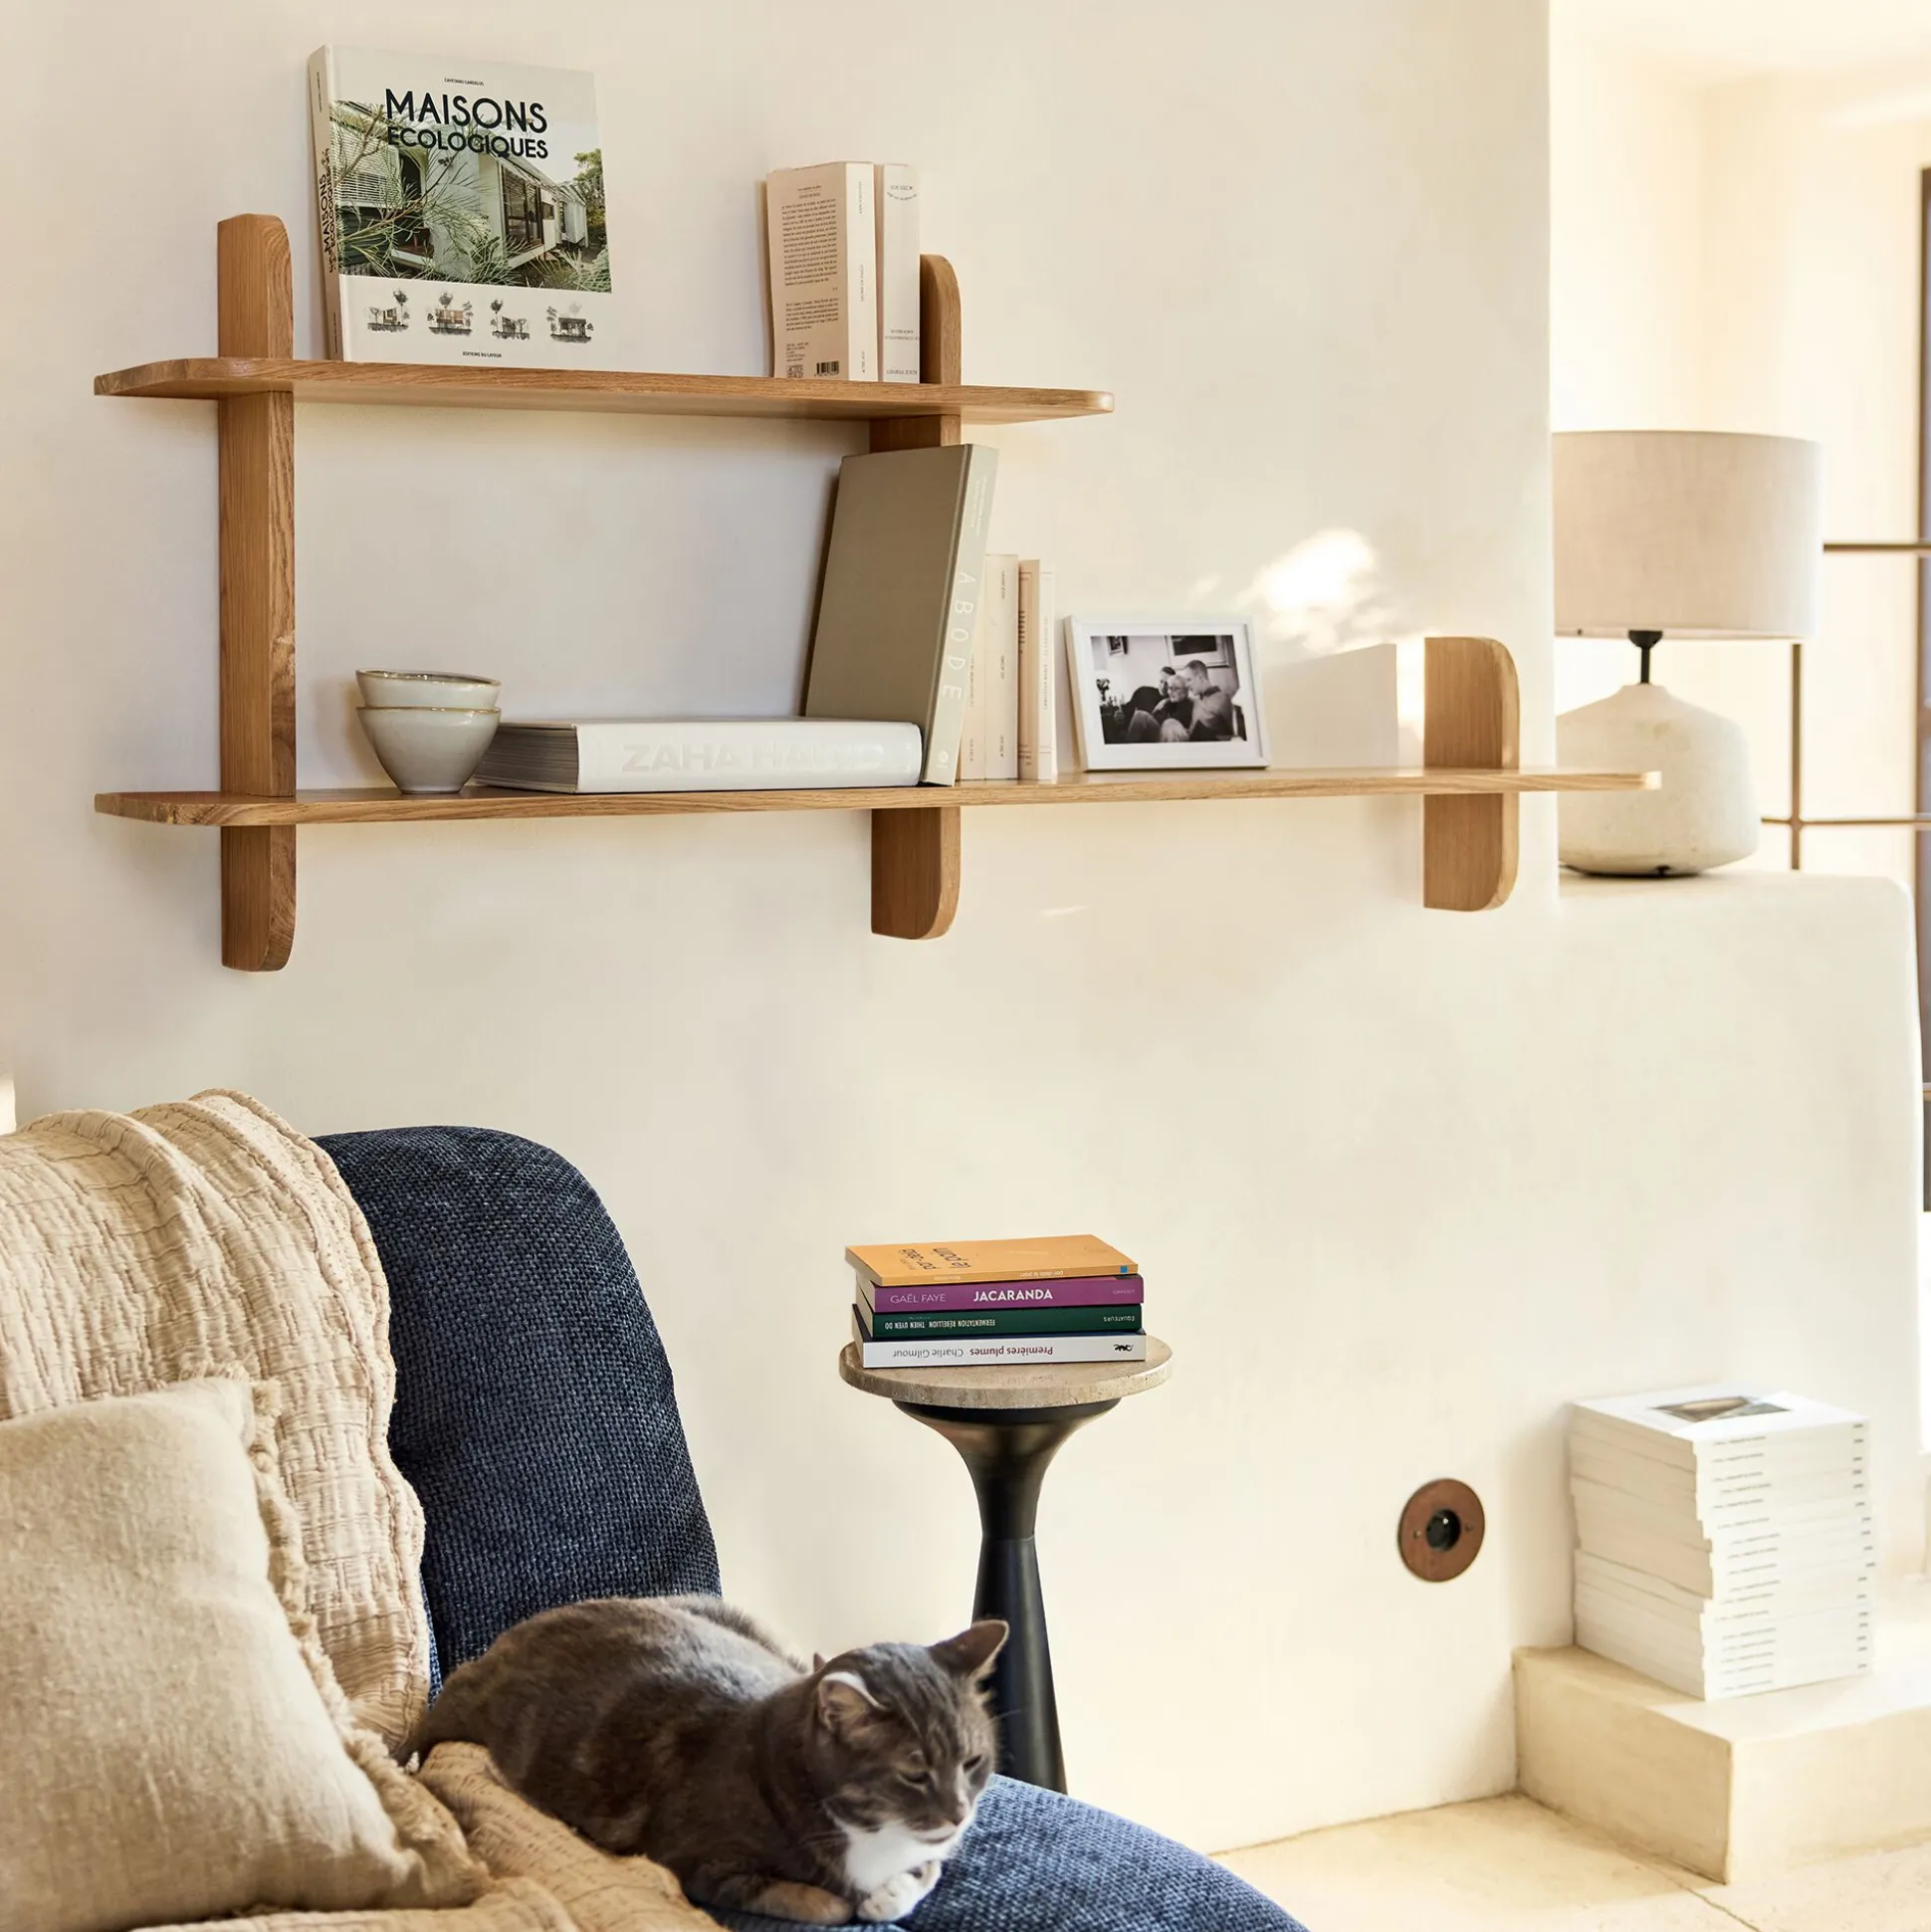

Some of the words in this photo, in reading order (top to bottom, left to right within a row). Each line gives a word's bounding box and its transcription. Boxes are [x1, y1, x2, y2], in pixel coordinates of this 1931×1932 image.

[385, 88, 547, 133] MAISONS
[387, 125, 548, 159] ECOLOGIQUES
[320, 173, 330, 254] MAISONS
[944, 571, 977, 700] ABODE
[621, 742, 741, 773] ZAHA
[890, 1292, 919, 1304] GAËL
[921, 1292, 947, 1303] FAYE
[972, 1288, 1053, 1303] JACARANDA
[892, 1348, 930, 1359] Gilmour
[931, 1348, 965, 1359] Charlie
[969, 1346, 1005, 1357] plumes
[1006, 1346, 1053, 1357] Premières
